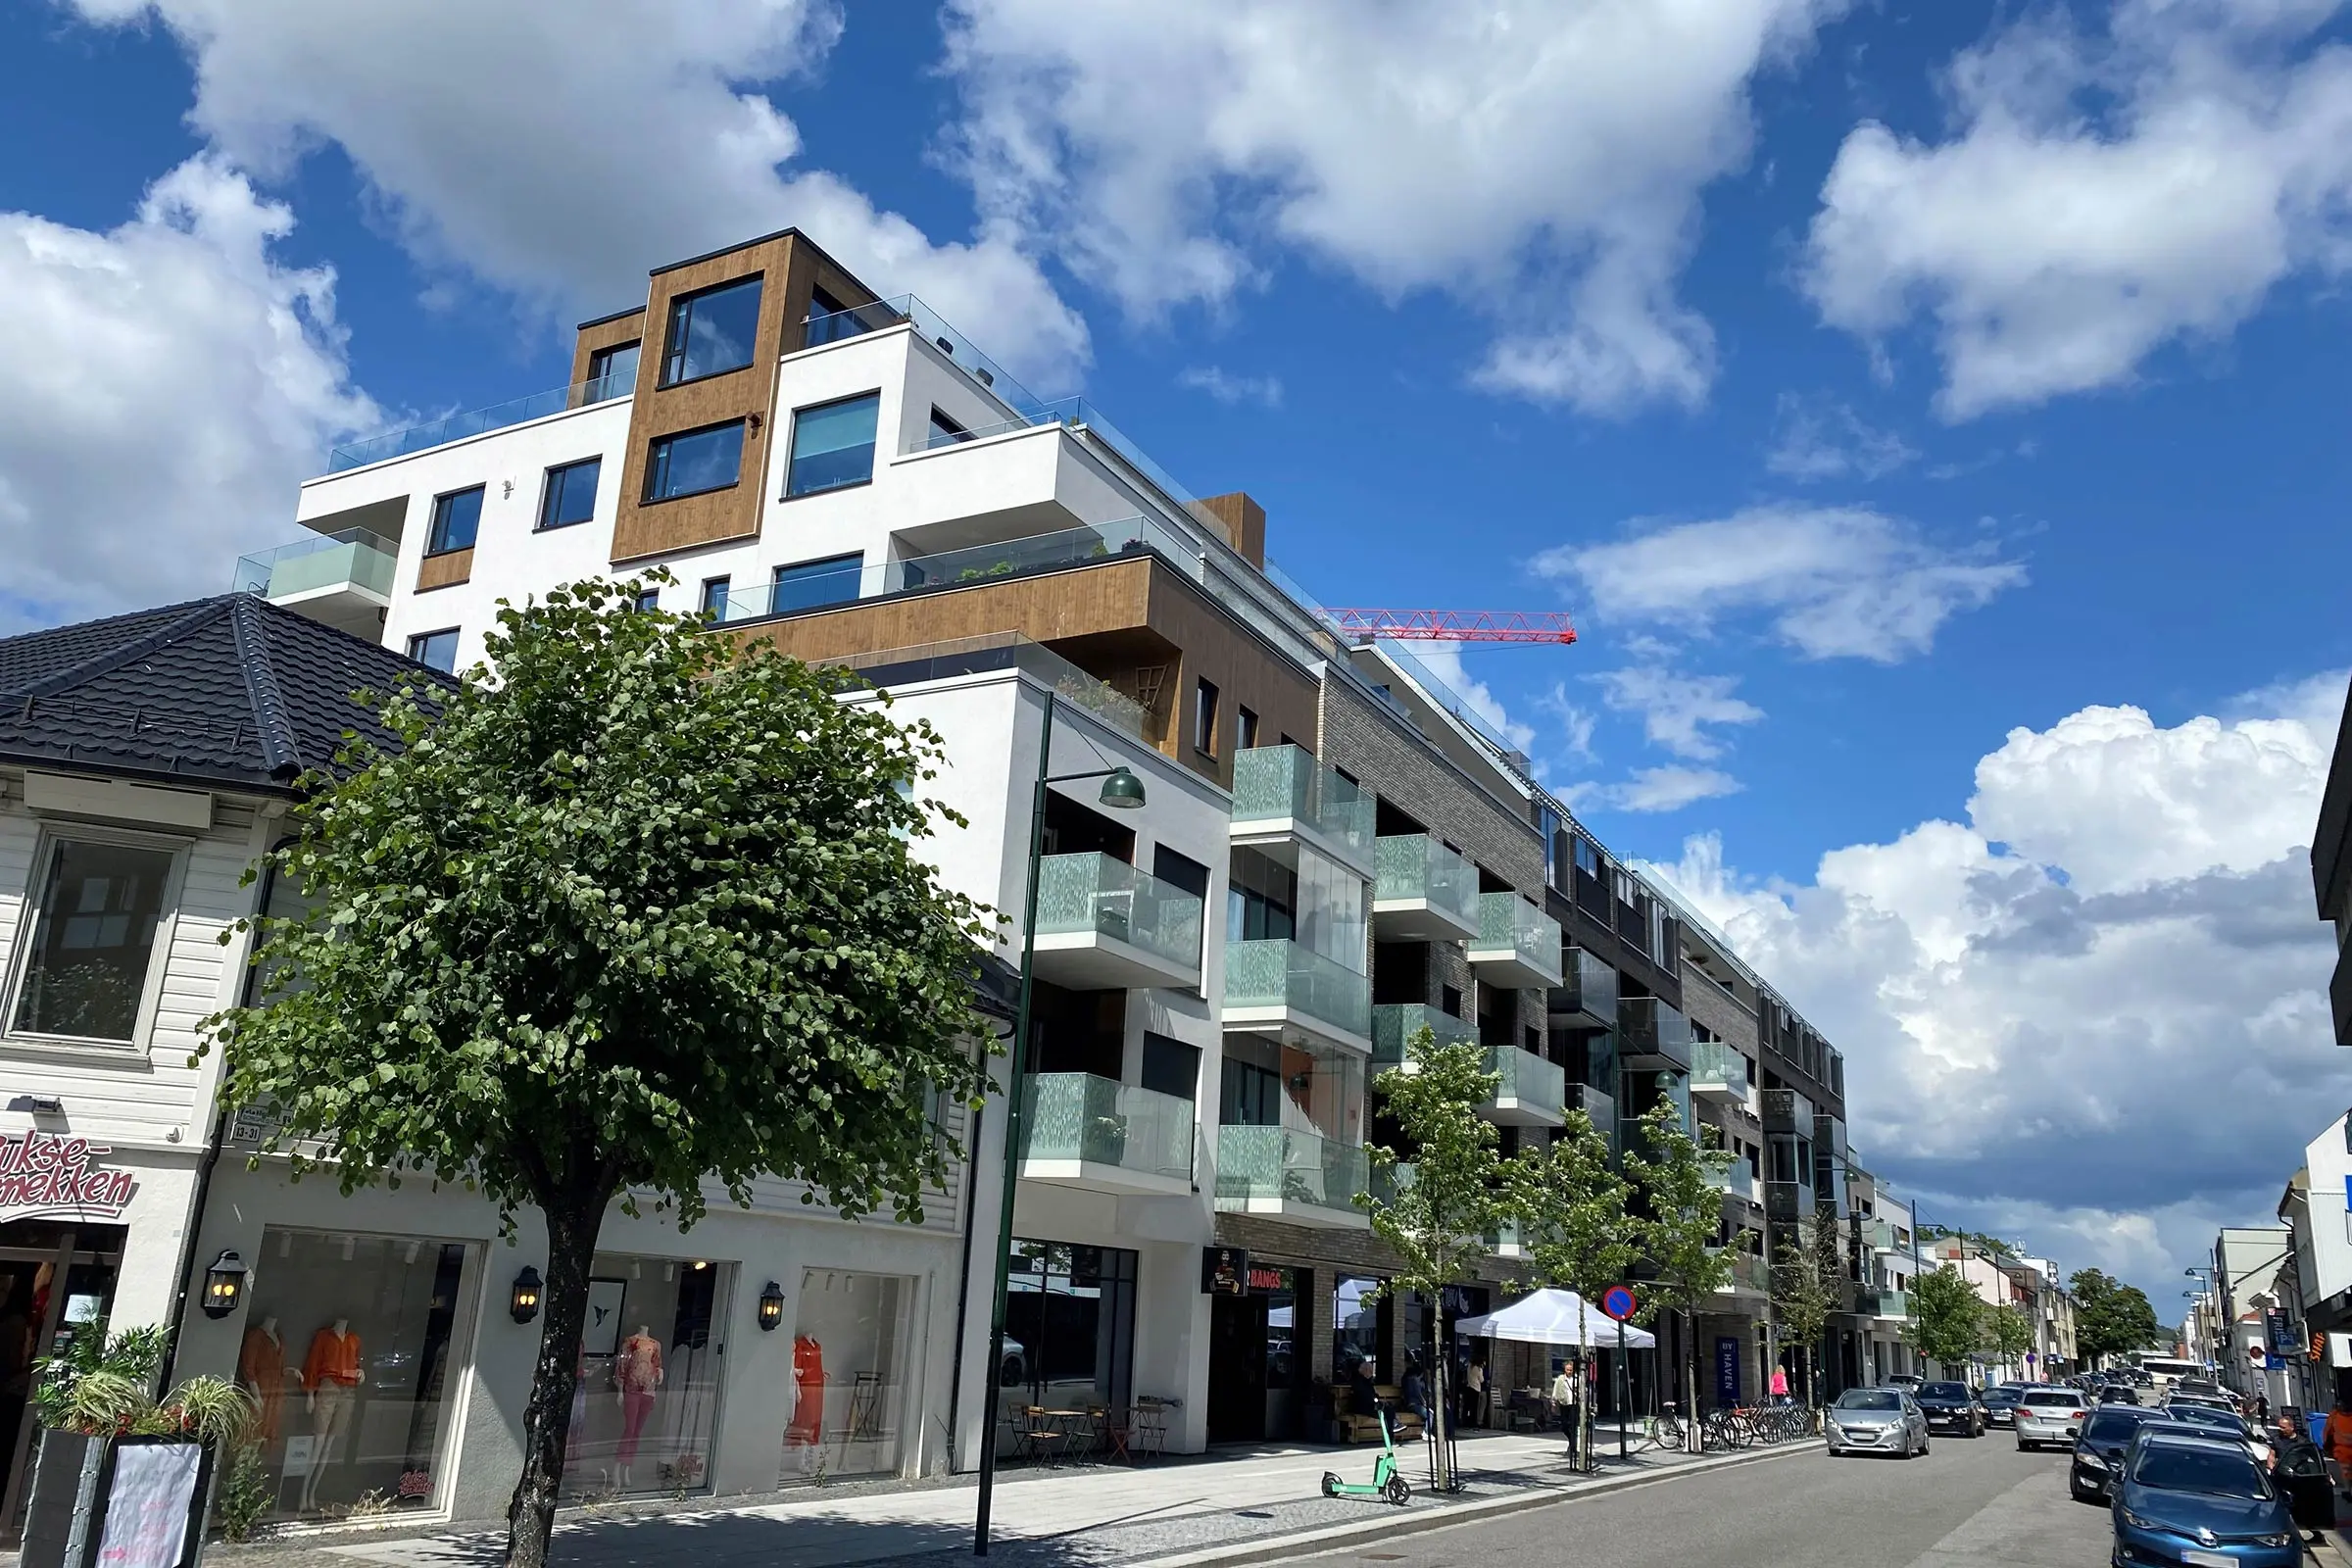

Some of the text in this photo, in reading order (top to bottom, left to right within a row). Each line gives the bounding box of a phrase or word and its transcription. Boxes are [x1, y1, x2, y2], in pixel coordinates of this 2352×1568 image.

[0, 1128, 112, 1176] ukse-
[0, 1163, 134, 1205] mekken
[1250, 1269, 1281, 1289] BANGS
[1722, 1342, 1734, 1350] BY
[1724, 1353, 1734, 1390] HAVEN
